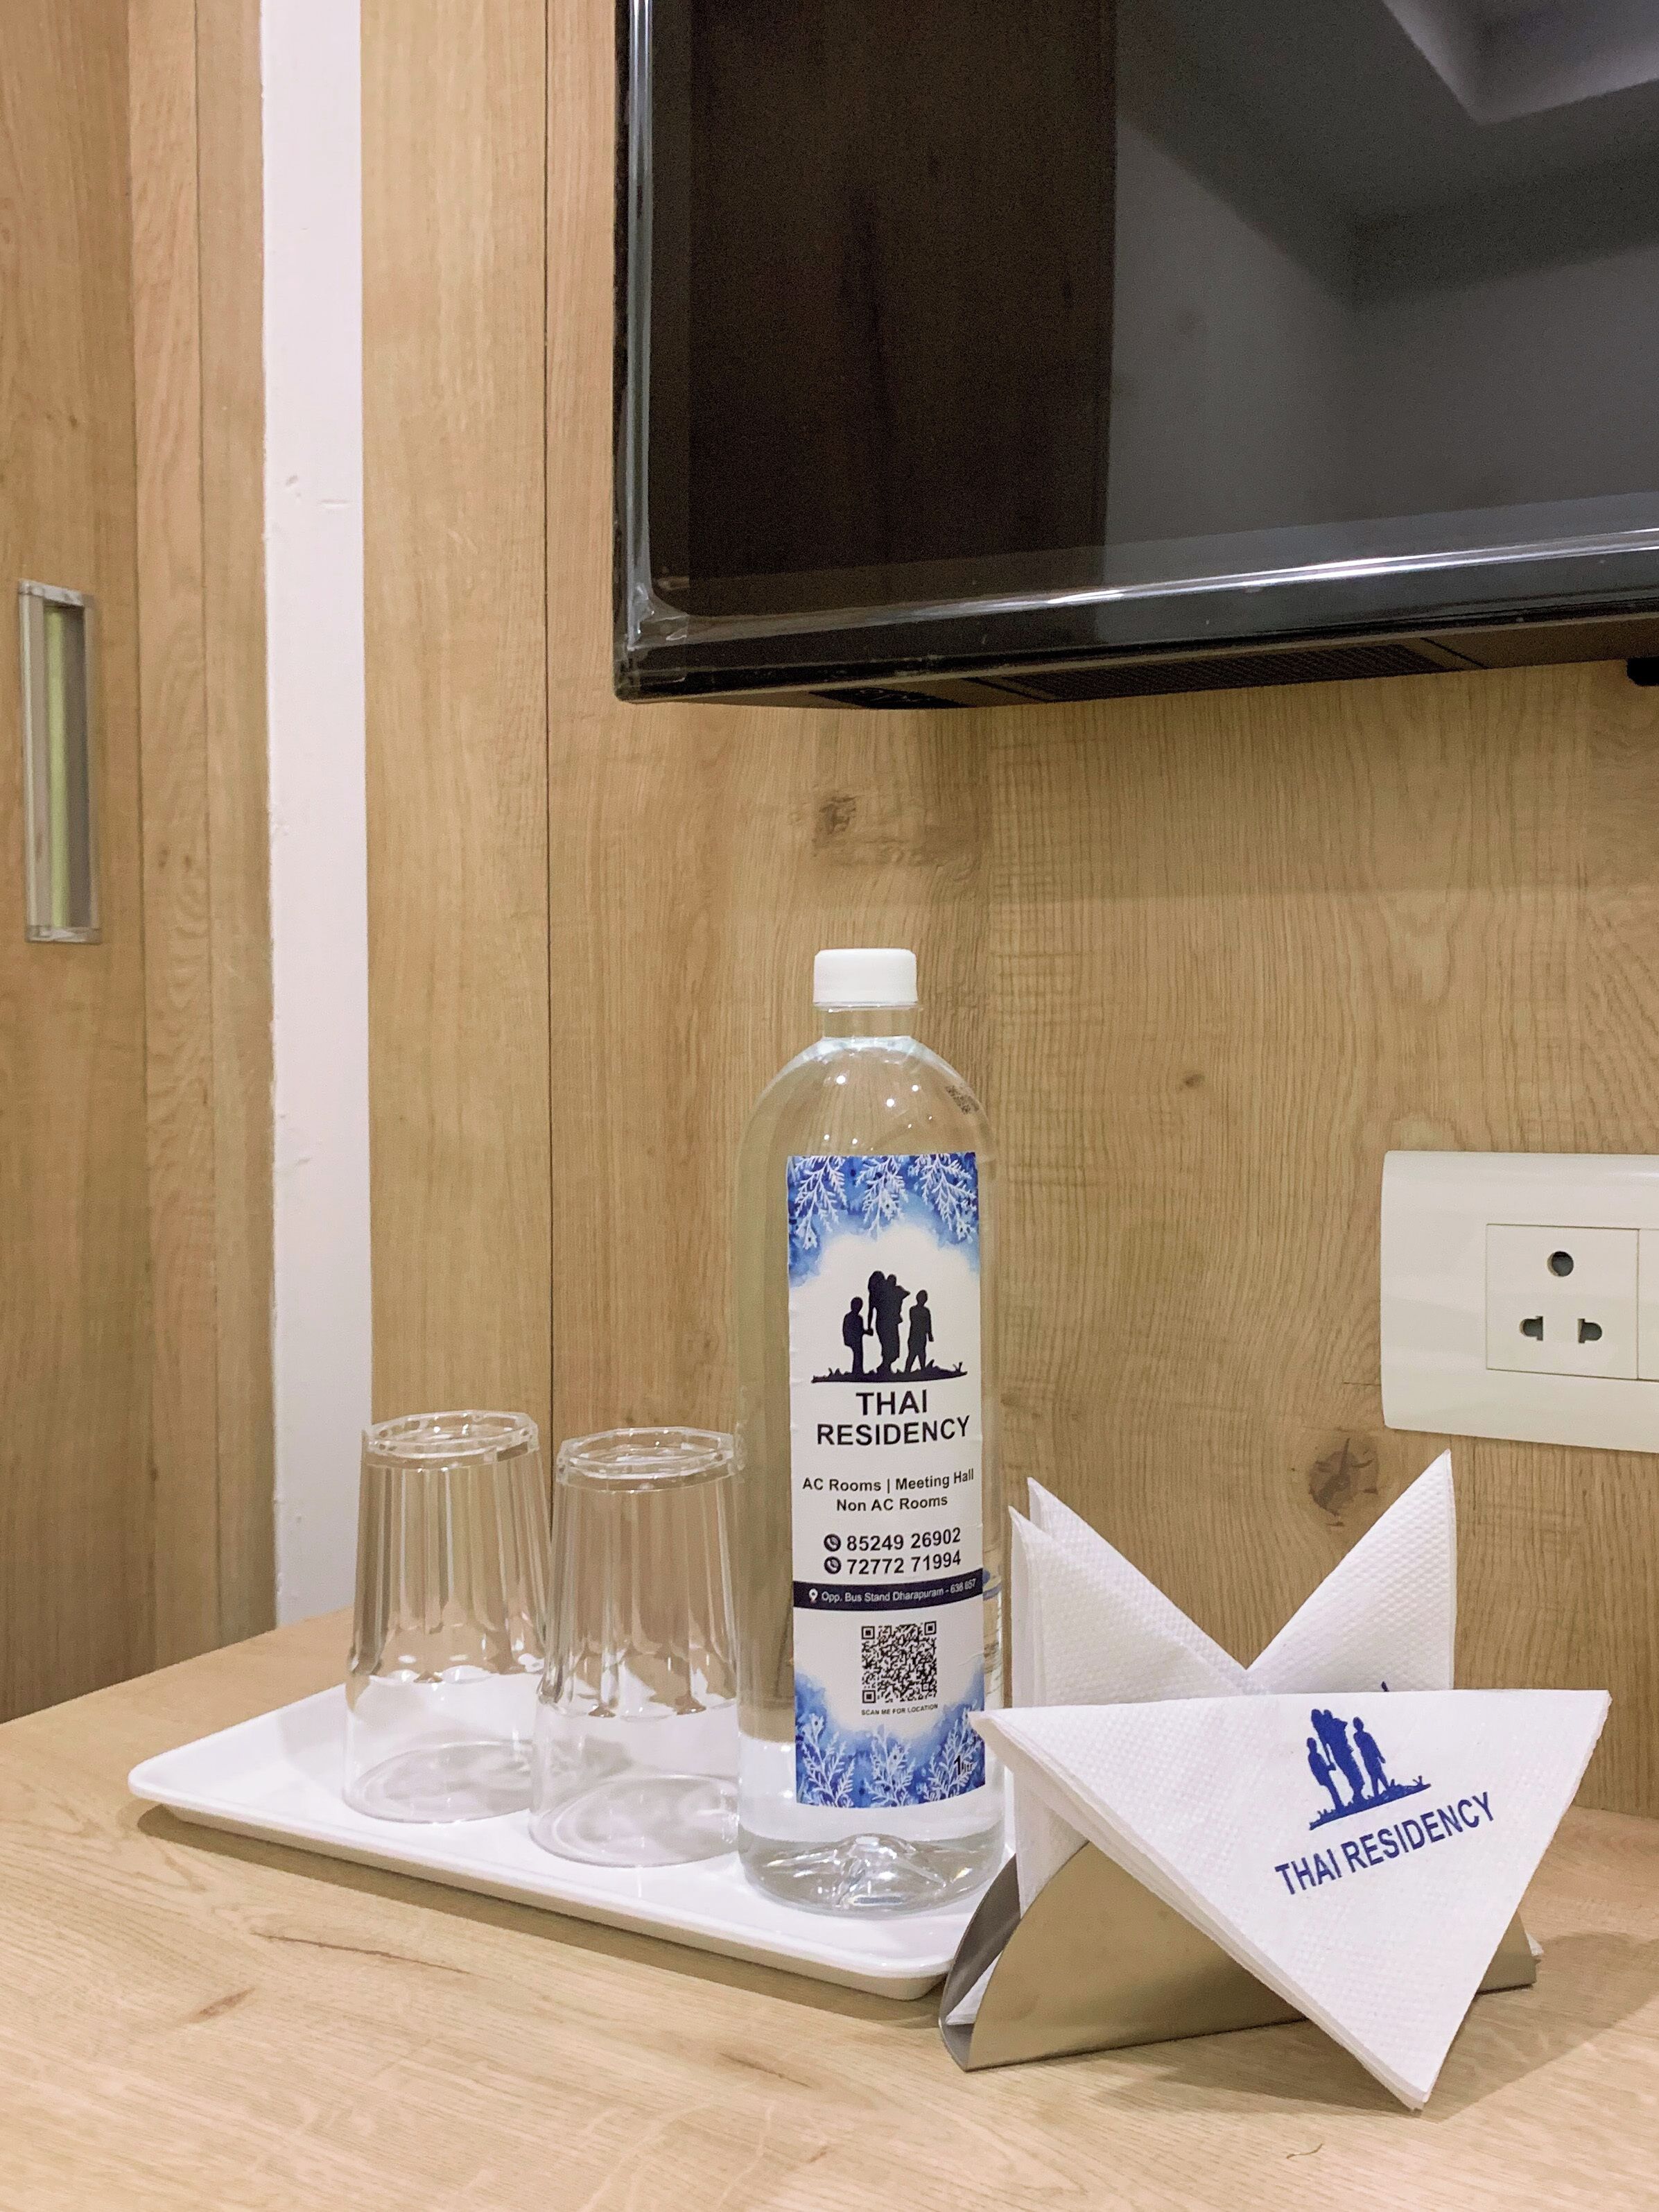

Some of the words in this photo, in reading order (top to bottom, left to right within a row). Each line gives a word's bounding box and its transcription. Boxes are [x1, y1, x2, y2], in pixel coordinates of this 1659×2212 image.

[855, 1389, 927, 1416] THAI
[817, 1415, 970, 1446] RESIDENCY
[802, 1477, 824, 1491] AC
[829, 1478, 881, 1492] Rooms
[896, 1476, 950, 1489] Meeting
[953, 1468, 974, 1484] Hall
[836, 1499, 866, 1512] Non
[871, 1498, 894, 1511] AC
[899, 1496, 948, 1510] Rooms
[846, 1534, 904, 1551] 85249
[910, 1527, 961, 1549] 26902
[847, 1557, 904, 1575] 72772
[911, 1550, 961, 1572] 71994
[822, 1591, 843, 1603] Opp.
[844, 1592, 862, 1602] Bus
[864, 1591, 890, 1602] Stand
[892, 1587, 944, 1602] Dharapuram
[907, 1704, 939, 1713] LOCATION
[1274, 1848, 1342, 1895] THAI
[1340, 1791, 1495, 1874] RESIDENCY
